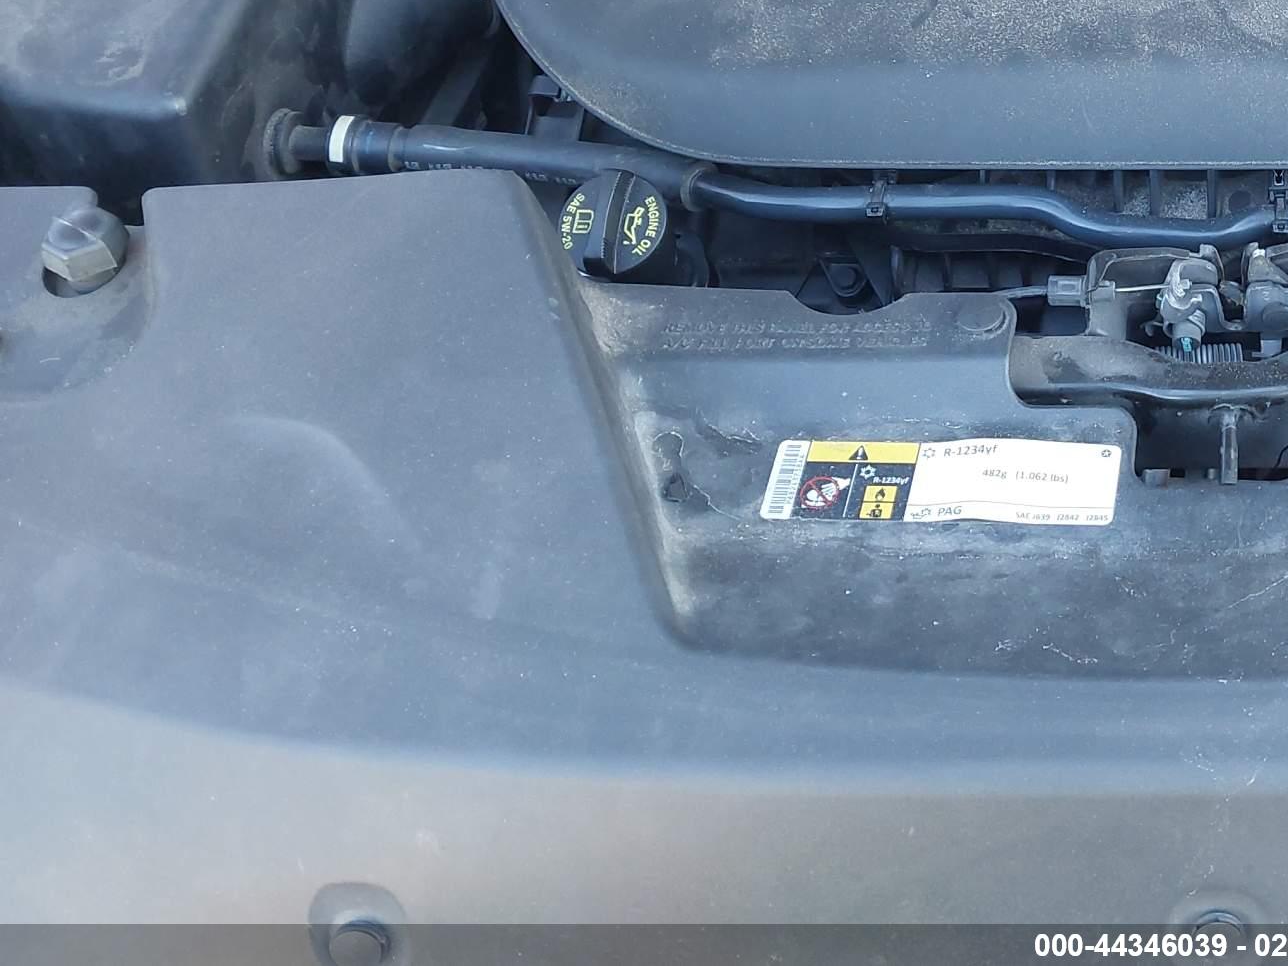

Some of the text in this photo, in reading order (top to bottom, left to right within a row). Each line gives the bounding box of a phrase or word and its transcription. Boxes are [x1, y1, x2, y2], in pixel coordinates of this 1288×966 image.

[560, 193, 585, 250] SAE 5W-20
[632, 196, 660, 256] ENGINE OIL
[943, 444, 999, 458] R-1234yf
[872, 475, 910, 487] R-1234yf
[981, 469, 1070, 484] 482g (1.062 lbs)
[937, 506, 963, 517] PAG
